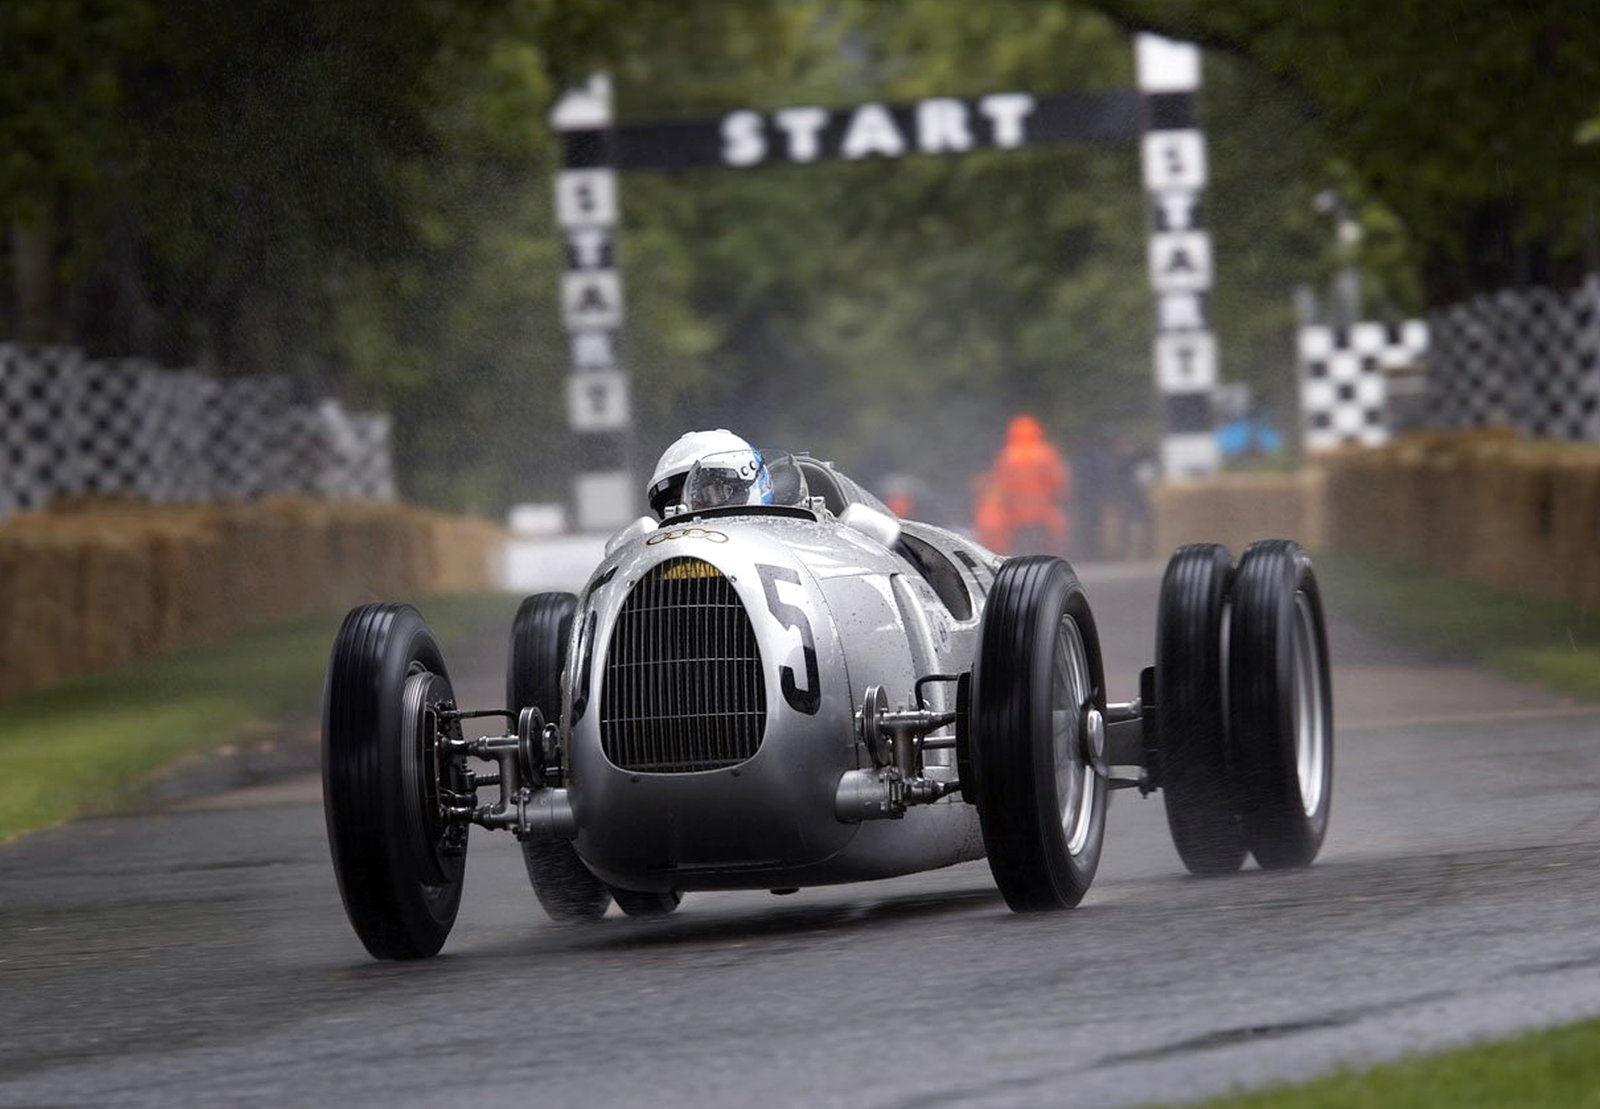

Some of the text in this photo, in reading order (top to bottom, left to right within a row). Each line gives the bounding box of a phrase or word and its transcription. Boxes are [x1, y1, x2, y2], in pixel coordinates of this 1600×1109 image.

[720, 93, 1036, 167] START
[564, 179, 614, 416] START
[1157, 142, 1202, 378] START
[755, 563, 821, 716] 5
